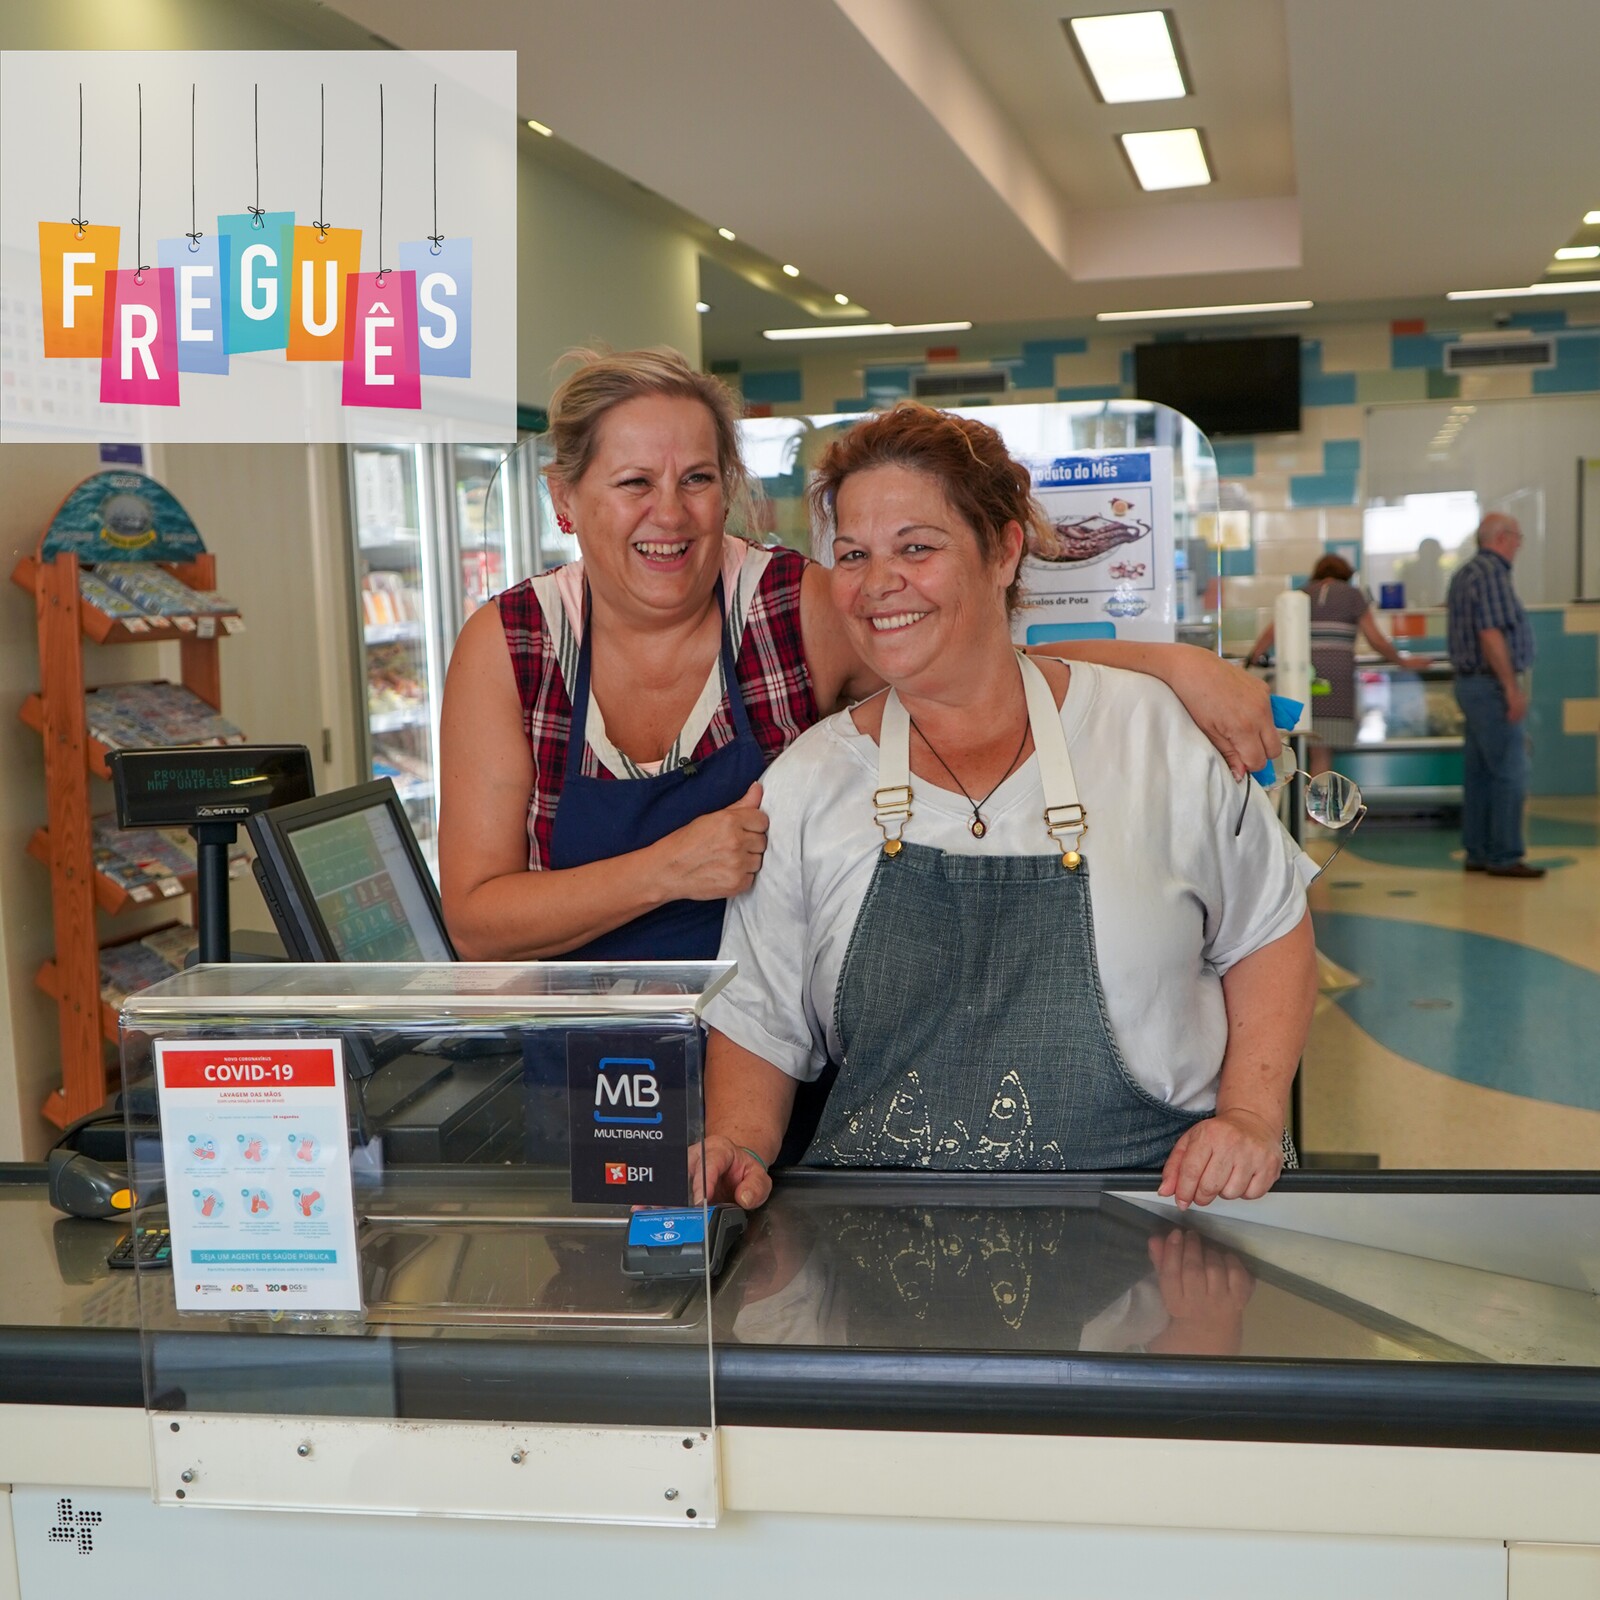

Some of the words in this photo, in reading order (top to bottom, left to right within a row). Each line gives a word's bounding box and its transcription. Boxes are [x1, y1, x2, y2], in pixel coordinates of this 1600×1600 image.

[1031, 465, 1071, 481] roduto
[1074, 462, 1089, 479] do
[1091, 461, 1118, 478] Mês
[1022, 597, 1054, 606] táculos
[1056, 597, 1067, 605] de
[1068, 596, 1089, 604] Pota
[204, 1064, 294, 1081] COVID-19
[263, 1089, 282, 1097] MÃOS
[594, 1073, 660, 1107] MB
[593, 1128, 663, 1140] MULTIBANCO
[627, 1167, 653, 1182] BPI
[200, 1253, 216, 1261] SEJA
[231, 1252, 260, 1260] AGENTE
[261, 1252, 271, 1260] DE
[273, 1251, 298, 1260] SAÚDE
[299, 1251, 330, 1260] PÚBLICA
